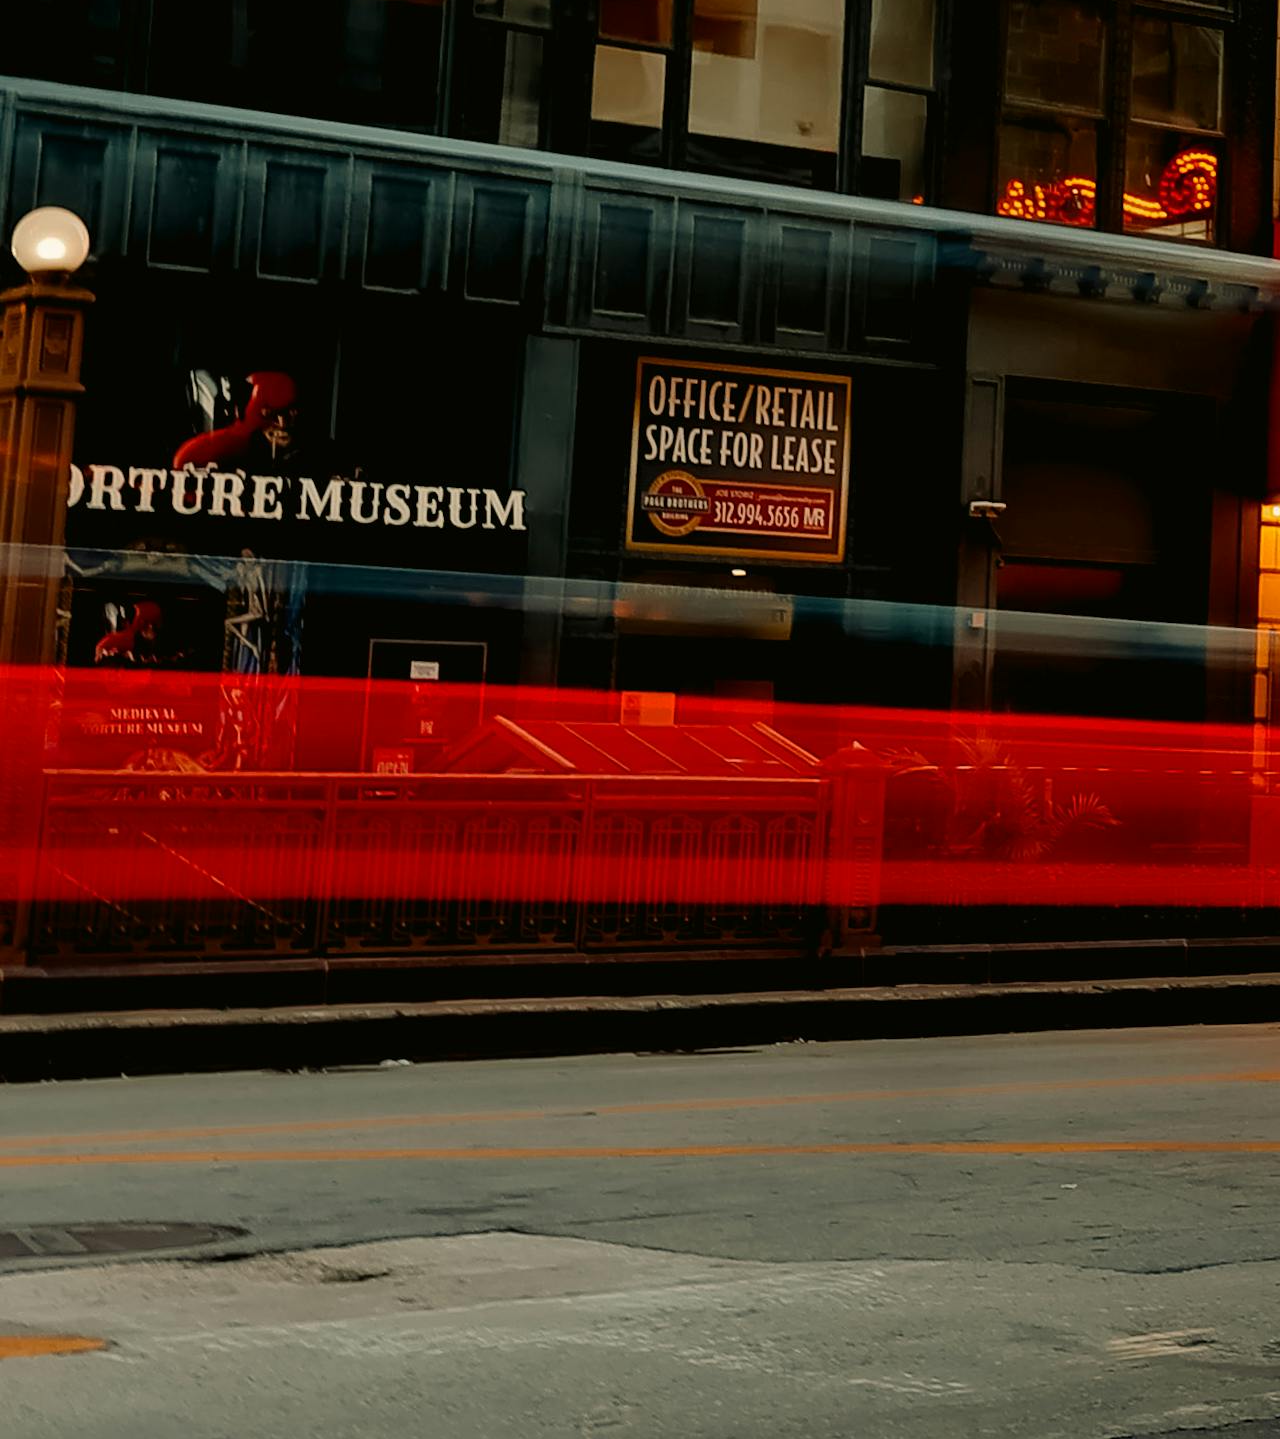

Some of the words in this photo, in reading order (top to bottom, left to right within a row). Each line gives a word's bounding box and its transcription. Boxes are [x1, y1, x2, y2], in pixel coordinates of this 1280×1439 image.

[649, 375, 838, 431] OFFICE/RETAIL
[644, 424, 714, 465] SPACE
[719, 430, 764, 469] FOR
[771, 435, 837, 475] LEASE
[296, 476, 528, 531] MUSEUM
[666, 496, 709, 511] BROTHERS
[713, 501, 800, 528] 312.994.5656
[110, 708, 176, 720] MEDIEVAL
[81, 722, 145, 735] TORTURE
[146, 723, 203, 735] MUSEUM
